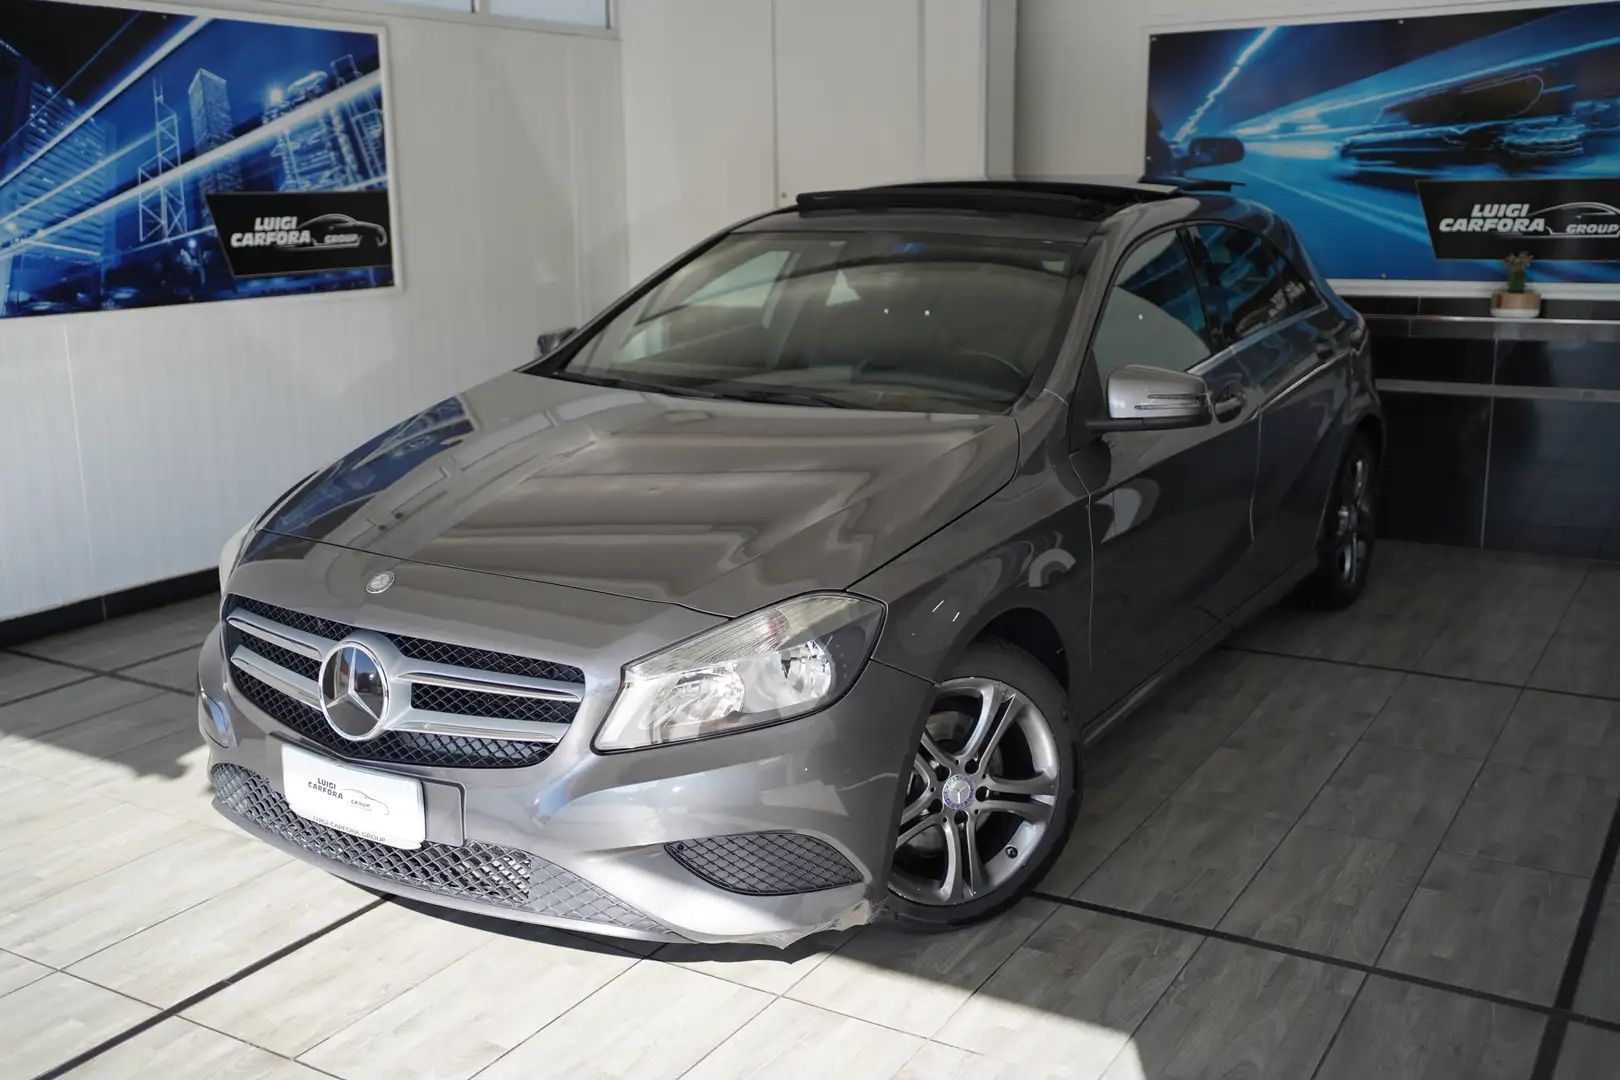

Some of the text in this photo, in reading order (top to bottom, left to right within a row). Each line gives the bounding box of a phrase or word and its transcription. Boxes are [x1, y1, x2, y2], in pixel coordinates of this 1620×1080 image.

[1471, 204, 1530, 218] LUIGI
[254, 216, 298, 231] LUIGI
[1439, 218, 1620, 234] CARFORA GROUP
[230, 230, 311, 248] CARFORA
[308, 781, 344, 799] CARFORA
[317, 777, 337, 790] LUIGI
[361, 831, 386, 842] GROUP
